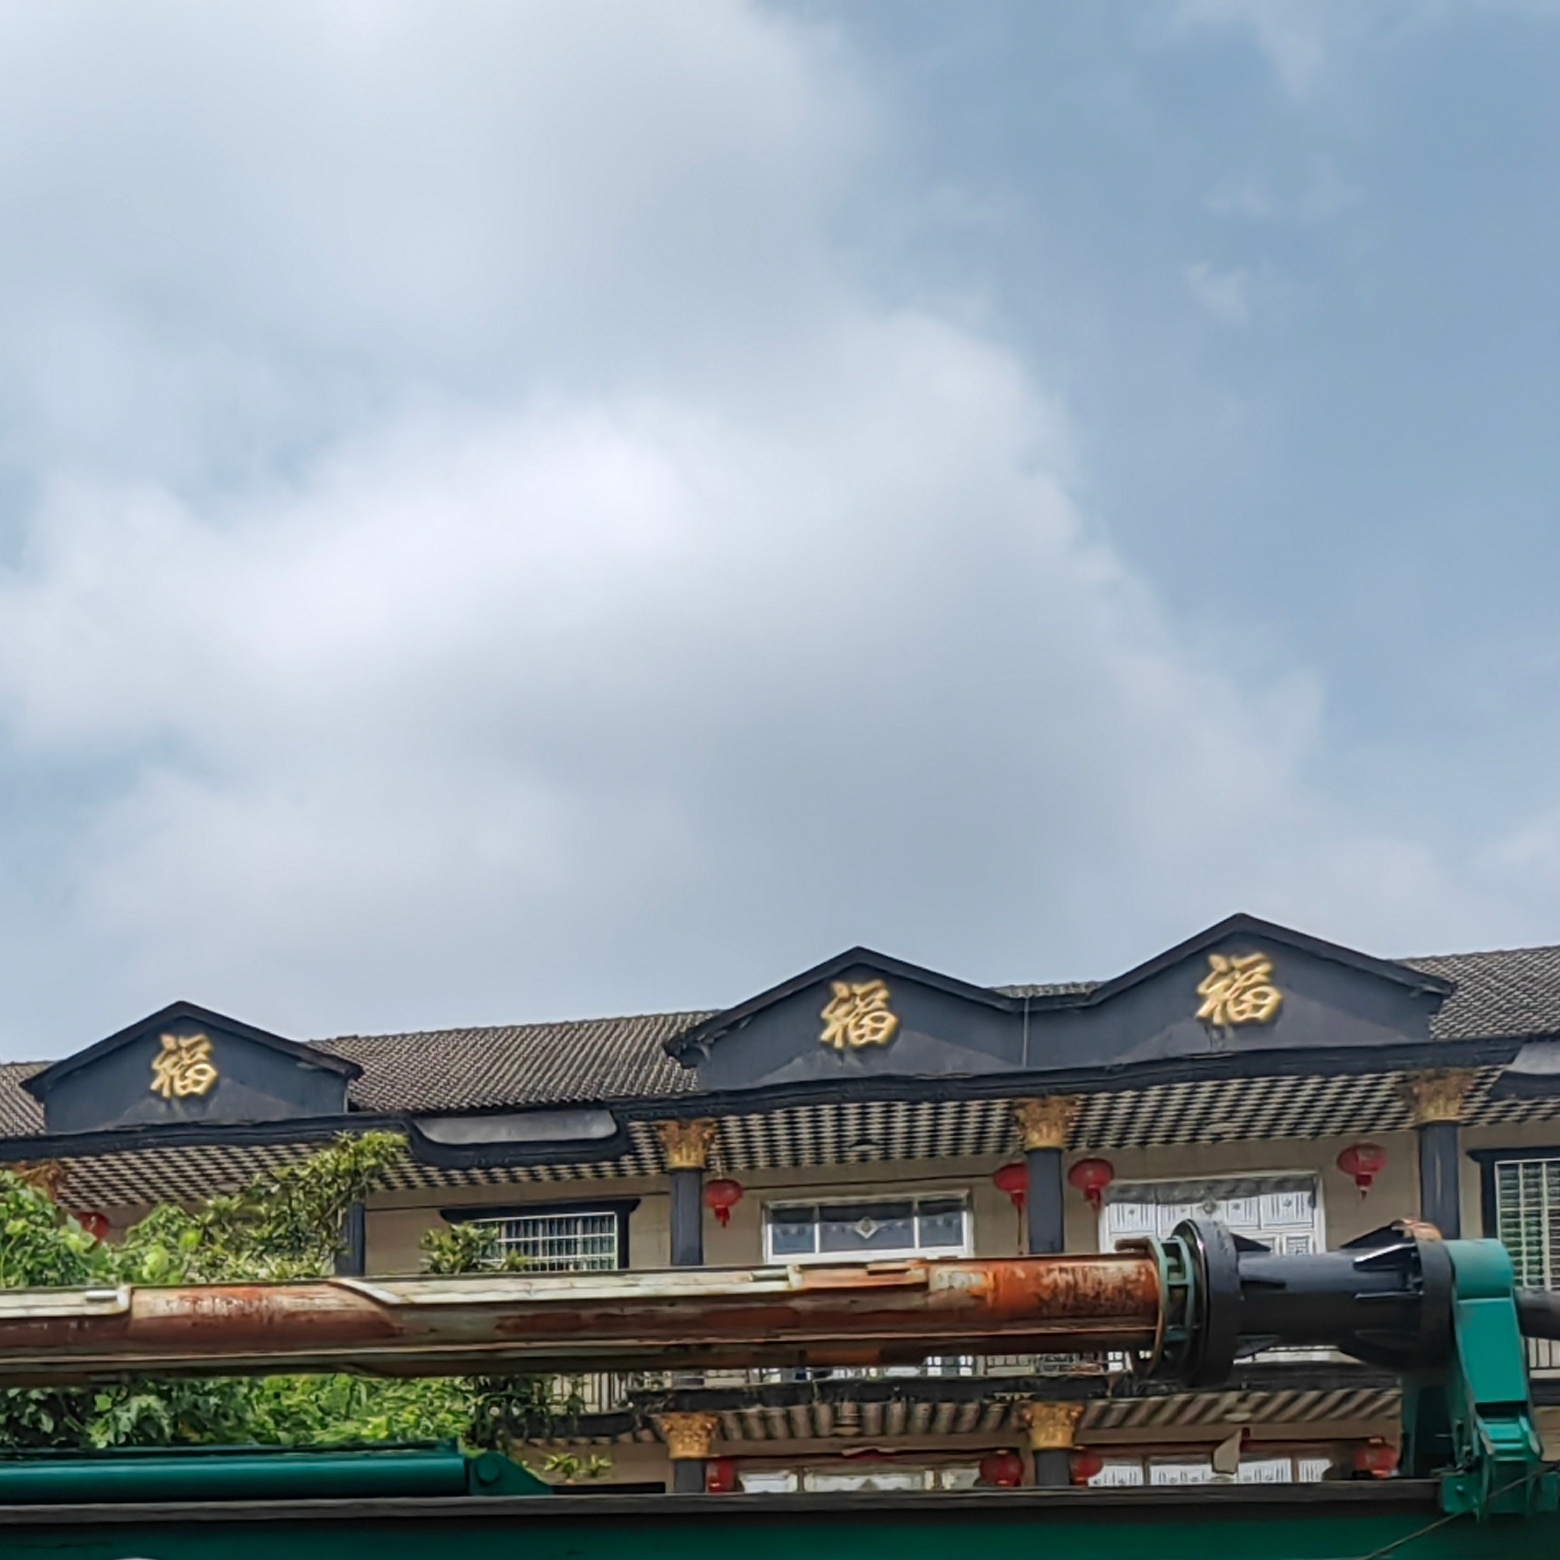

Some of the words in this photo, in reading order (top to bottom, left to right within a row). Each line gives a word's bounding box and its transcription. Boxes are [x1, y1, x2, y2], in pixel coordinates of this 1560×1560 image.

[820, 979, 897, 1048] 福
[1196, 952, 1283, 1026] 福
[151, 1033, 217, 1098] 福
